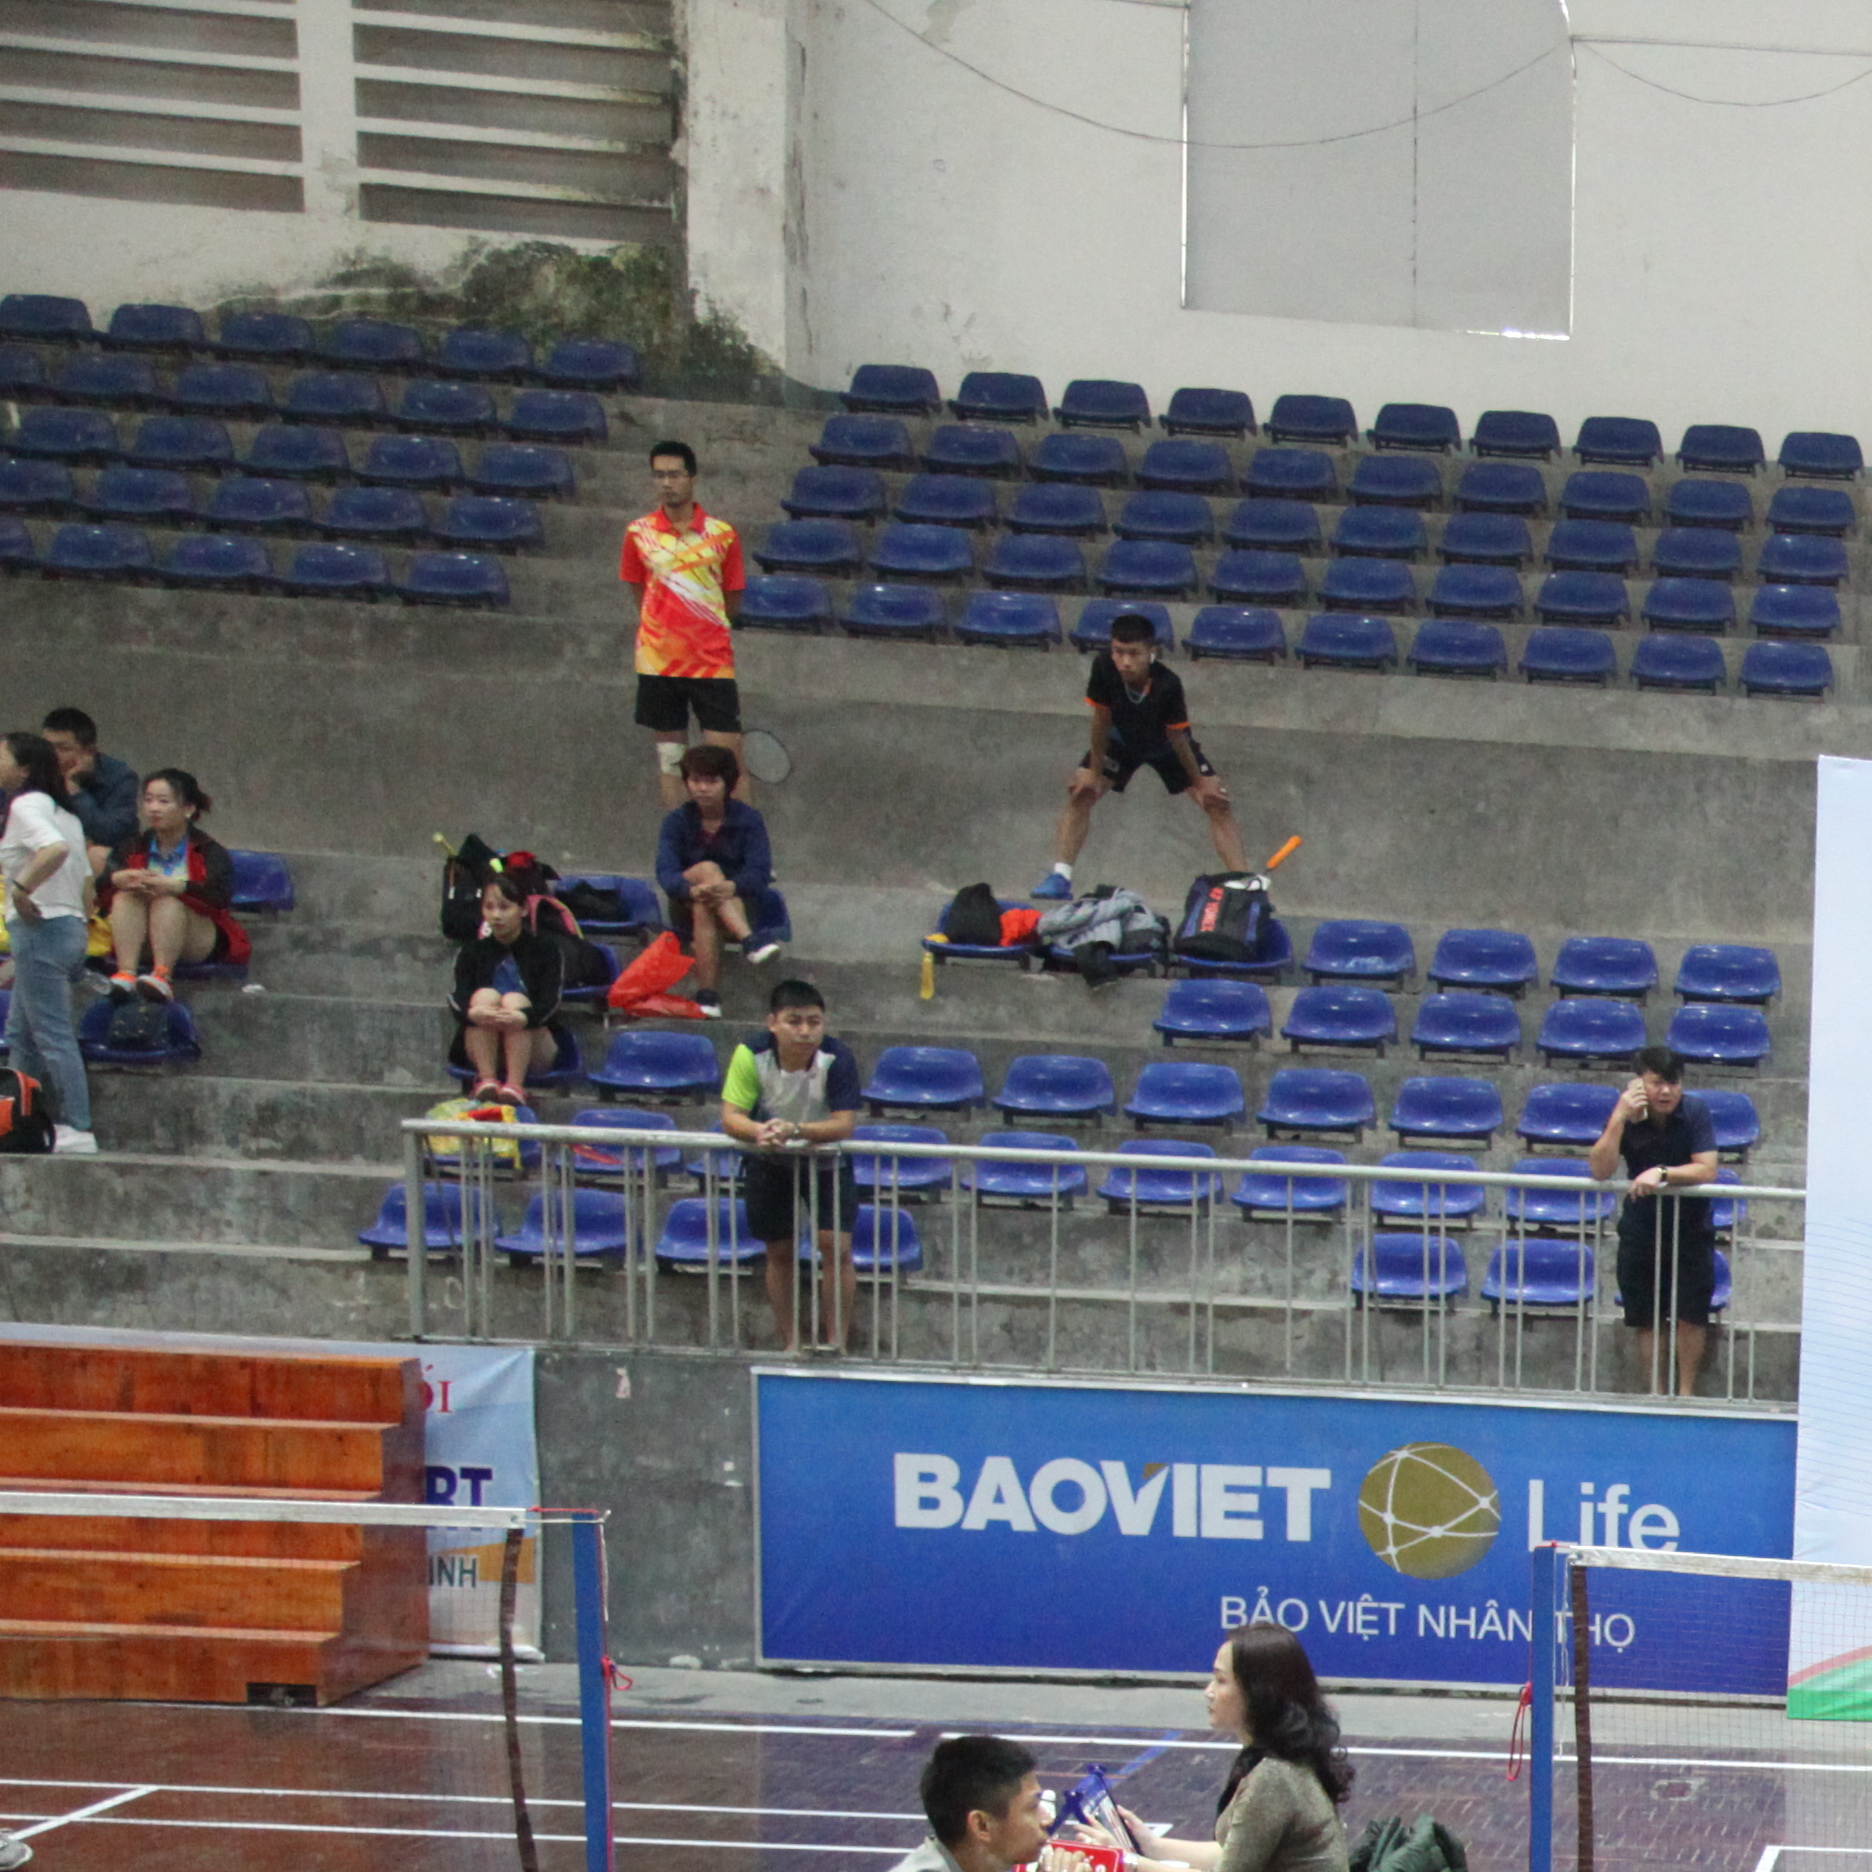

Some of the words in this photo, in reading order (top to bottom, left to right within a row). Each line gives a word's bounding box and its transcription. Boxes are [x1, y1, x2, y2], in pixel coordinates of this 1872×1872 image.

[894, 1451, 1331, 1542] BAOVIET
[1528, 1478, 1680, 1554] Life
[1220, 1585, 1310, 1632] BẢO
[1318, 1593, 1406, 1641] VIỆT
[1418, 1599, 1533, 1642] NHÂN
